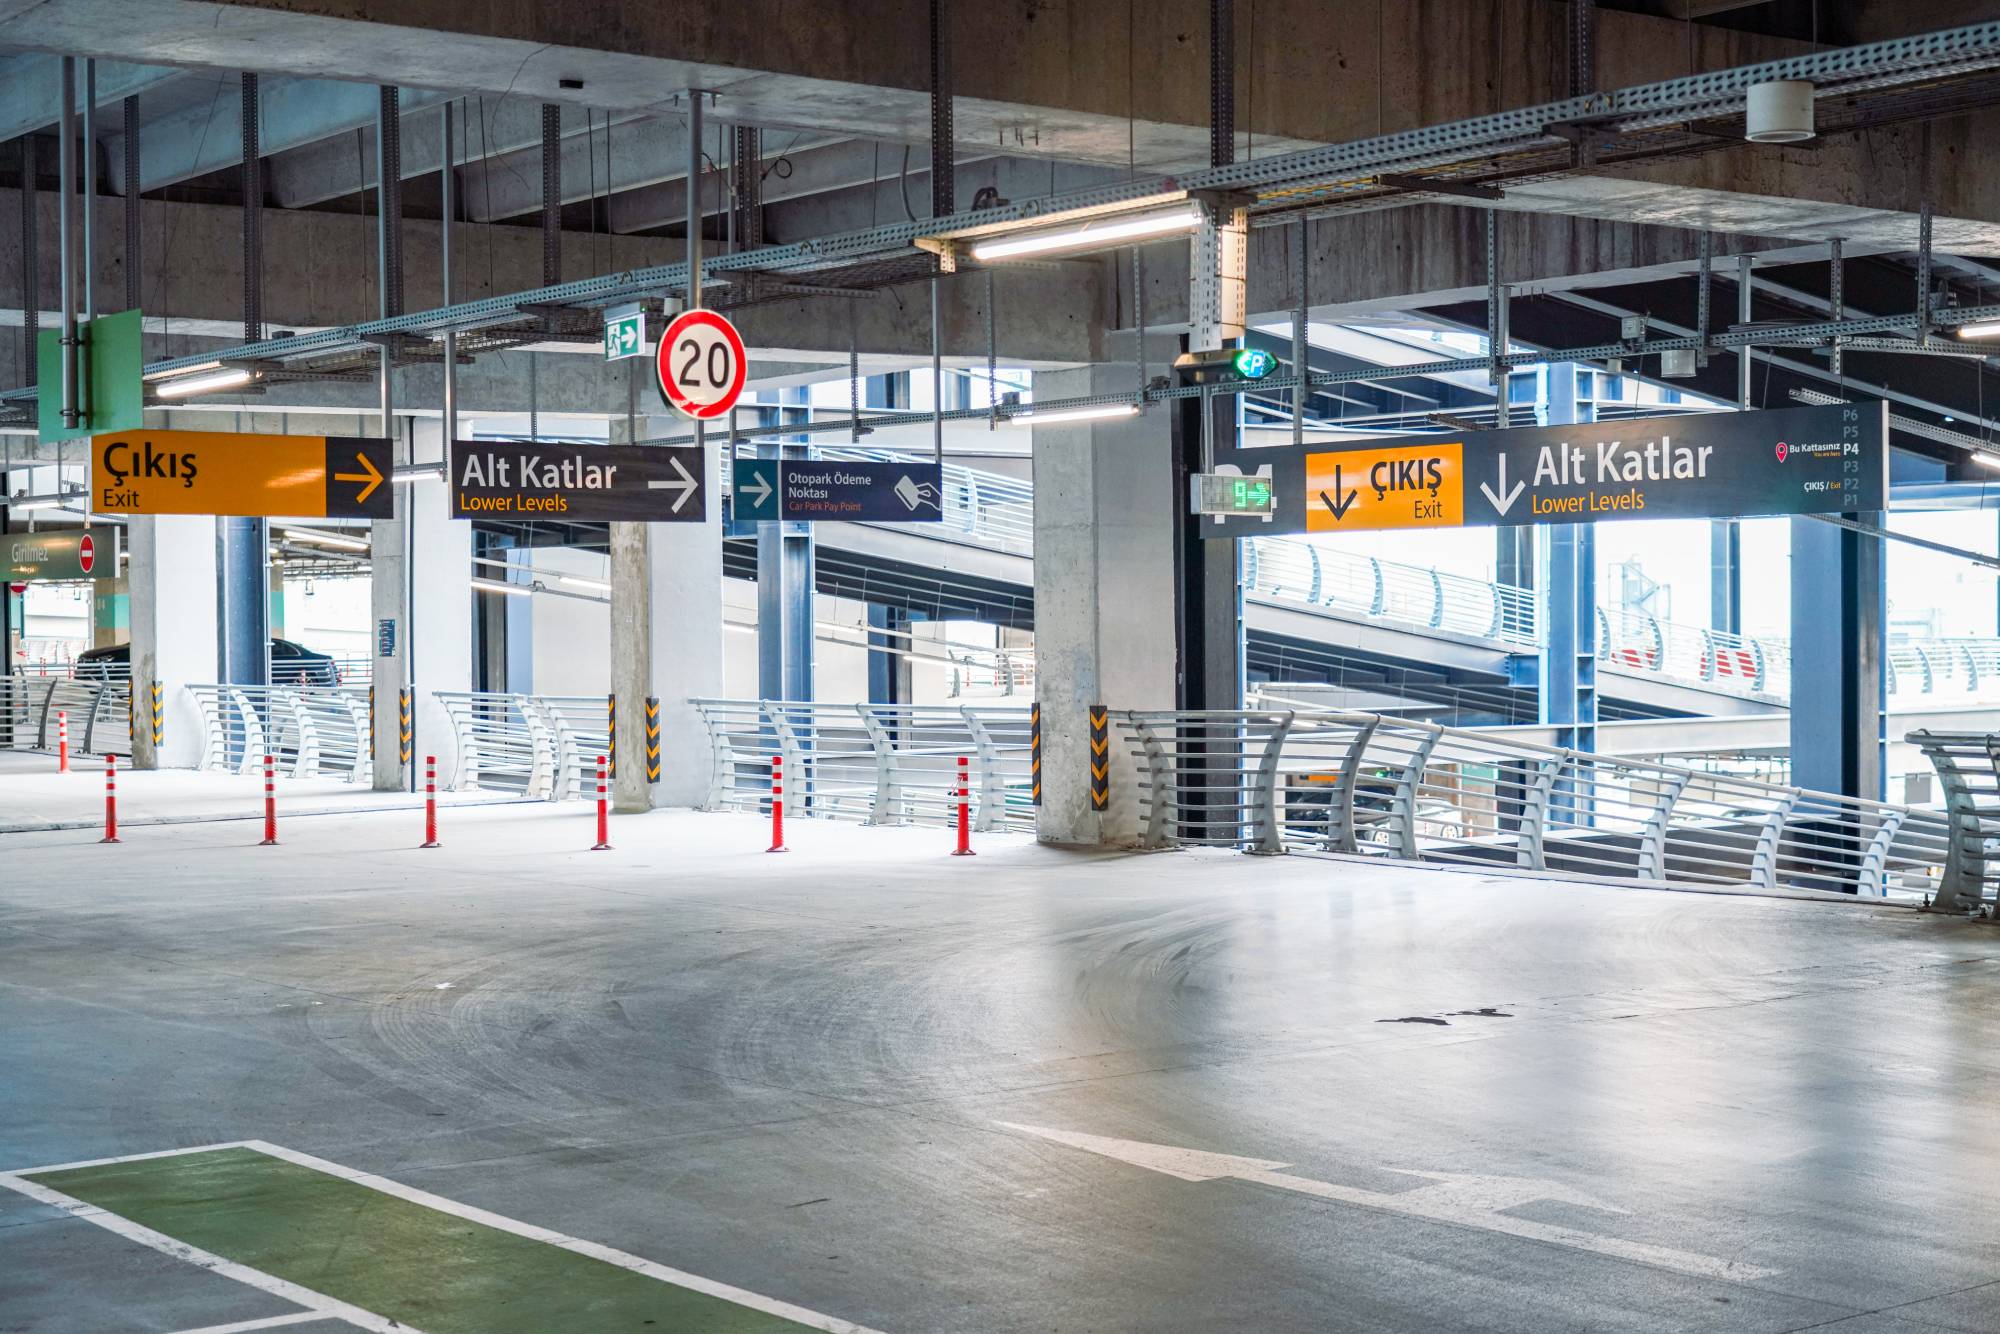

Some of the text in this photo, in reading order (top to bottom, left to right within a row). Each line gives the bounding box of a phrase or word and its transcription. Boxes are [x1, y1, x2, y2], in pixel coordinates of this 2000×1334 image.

[679, 339, 729, 389] 20
[1843, 409, 1859, 421] P6
[1843, 426, 1859, 438] P5
[1789, 443, 1841, 453] Bu Kattasınız
[1843, 443, 1860, 456] P4
[103, 442, 198, 488] Çıkış
[1533, 436, 1713, 487] Alt Katlar
[1843, 461, 1859, 473] P3
[461, 453, 617, 489] Alt Katlar
[788, 471, 872, 487] Otopark Ödeme
[1370, 458, 1442, 501] ÇIKIŞ
[1804, 481, 1825, 492] ÇIKIŞ
[1844, 478, 1859, 490] P2
[103, 489, 140, 507] Exit
[788, 487, 828, 499] Noktası
[1533, 488, 1645, 514] Lower Levels
[1844, 494, 1858, 506] P1
[460, 492, 568, 512] Lower Levels
[788, 502, 862, 513] Car Park Pay Point
[1414, 500, 1442, 519] Exit
[11, 543, 49, 562] Girilmez
